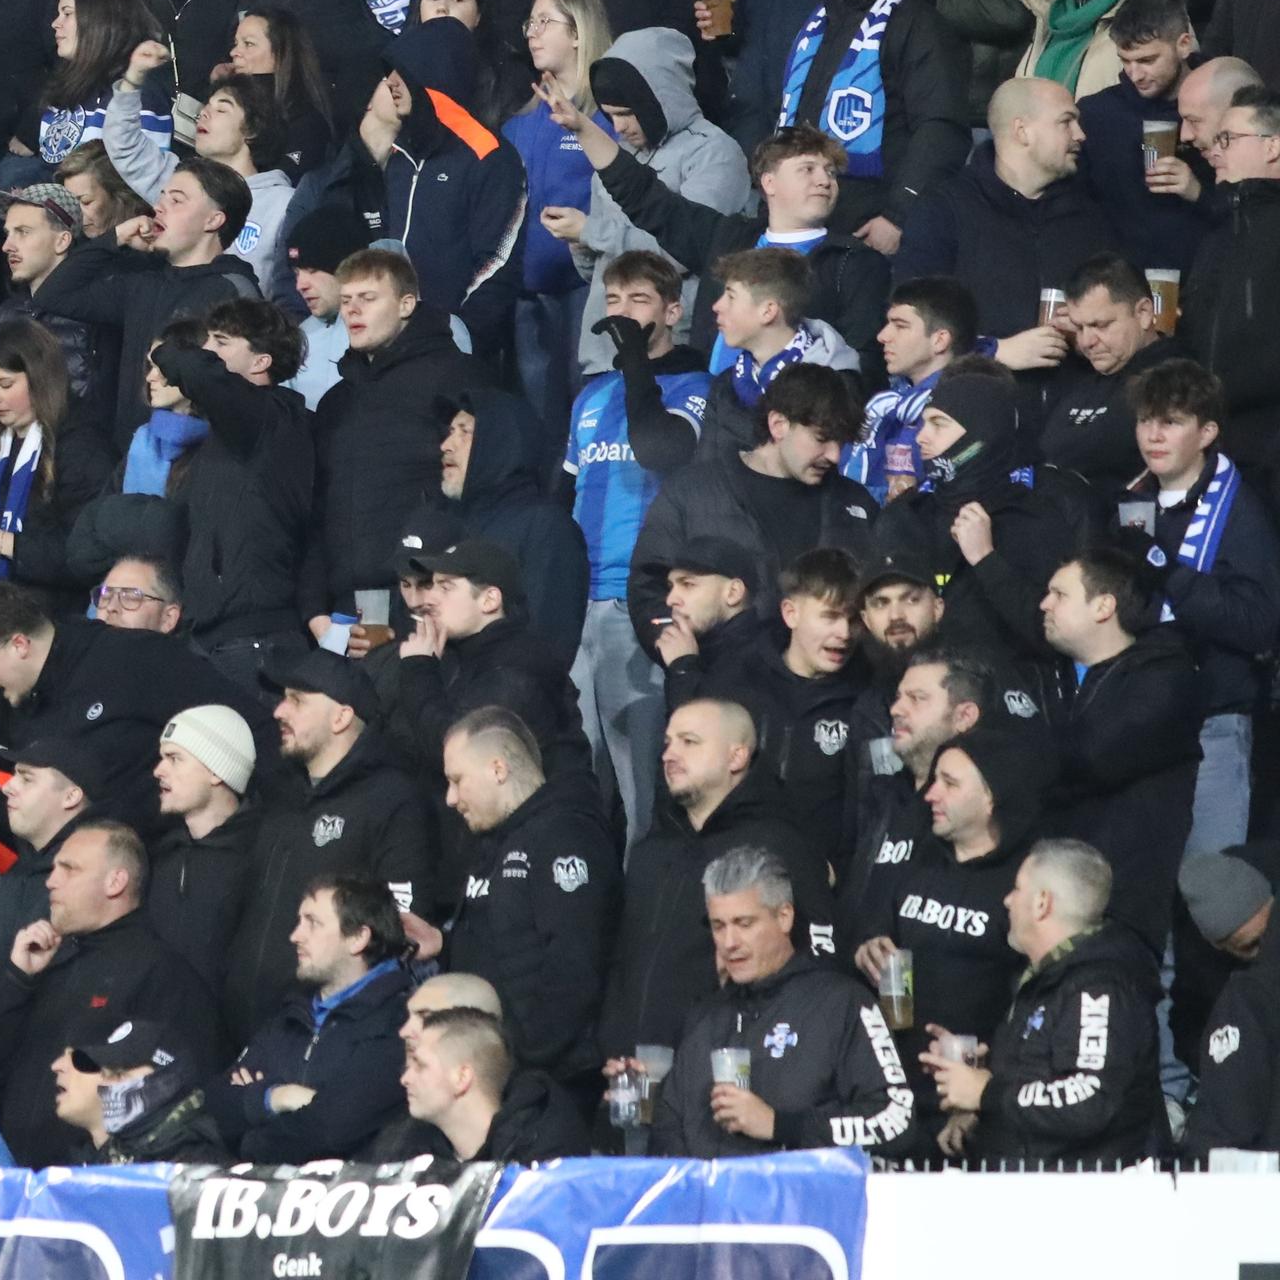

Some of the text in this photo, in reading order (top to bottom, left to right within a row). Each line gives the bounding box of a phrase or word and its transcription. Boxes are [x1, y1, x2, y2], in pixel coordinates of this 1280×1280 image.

[1076, 991, 1111, 1071] GENK
[192, 1179, 452, 1240] IB.BOYS
[273, 1253, 322, 1278] Genk
